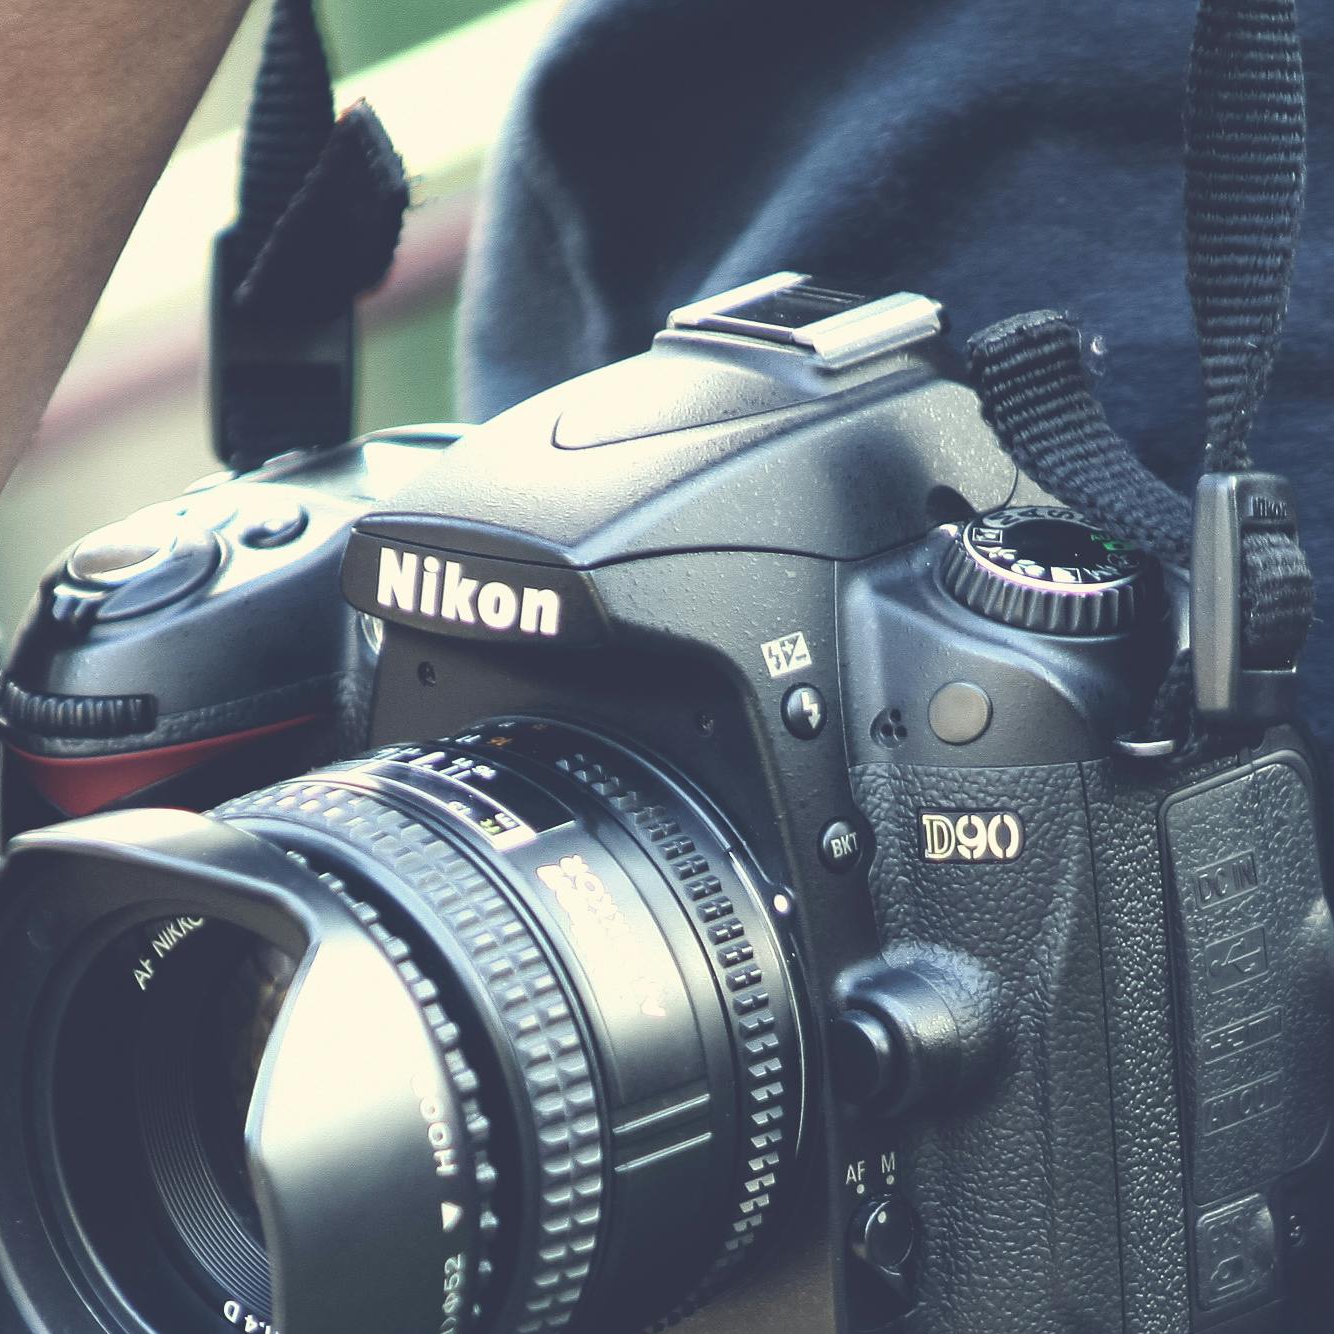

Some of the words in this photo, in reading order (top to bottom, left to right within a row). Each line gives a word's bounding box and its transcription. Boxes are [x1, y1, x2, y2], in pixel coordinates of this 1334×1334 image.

[376, 547, 560, 636] Nikon
[830, 832, 858, 859] BKT
[922, 814, 1020, 860] D90
[846, 1160, 866, 1185] AF
[881, 1151, 895, 1174] M
